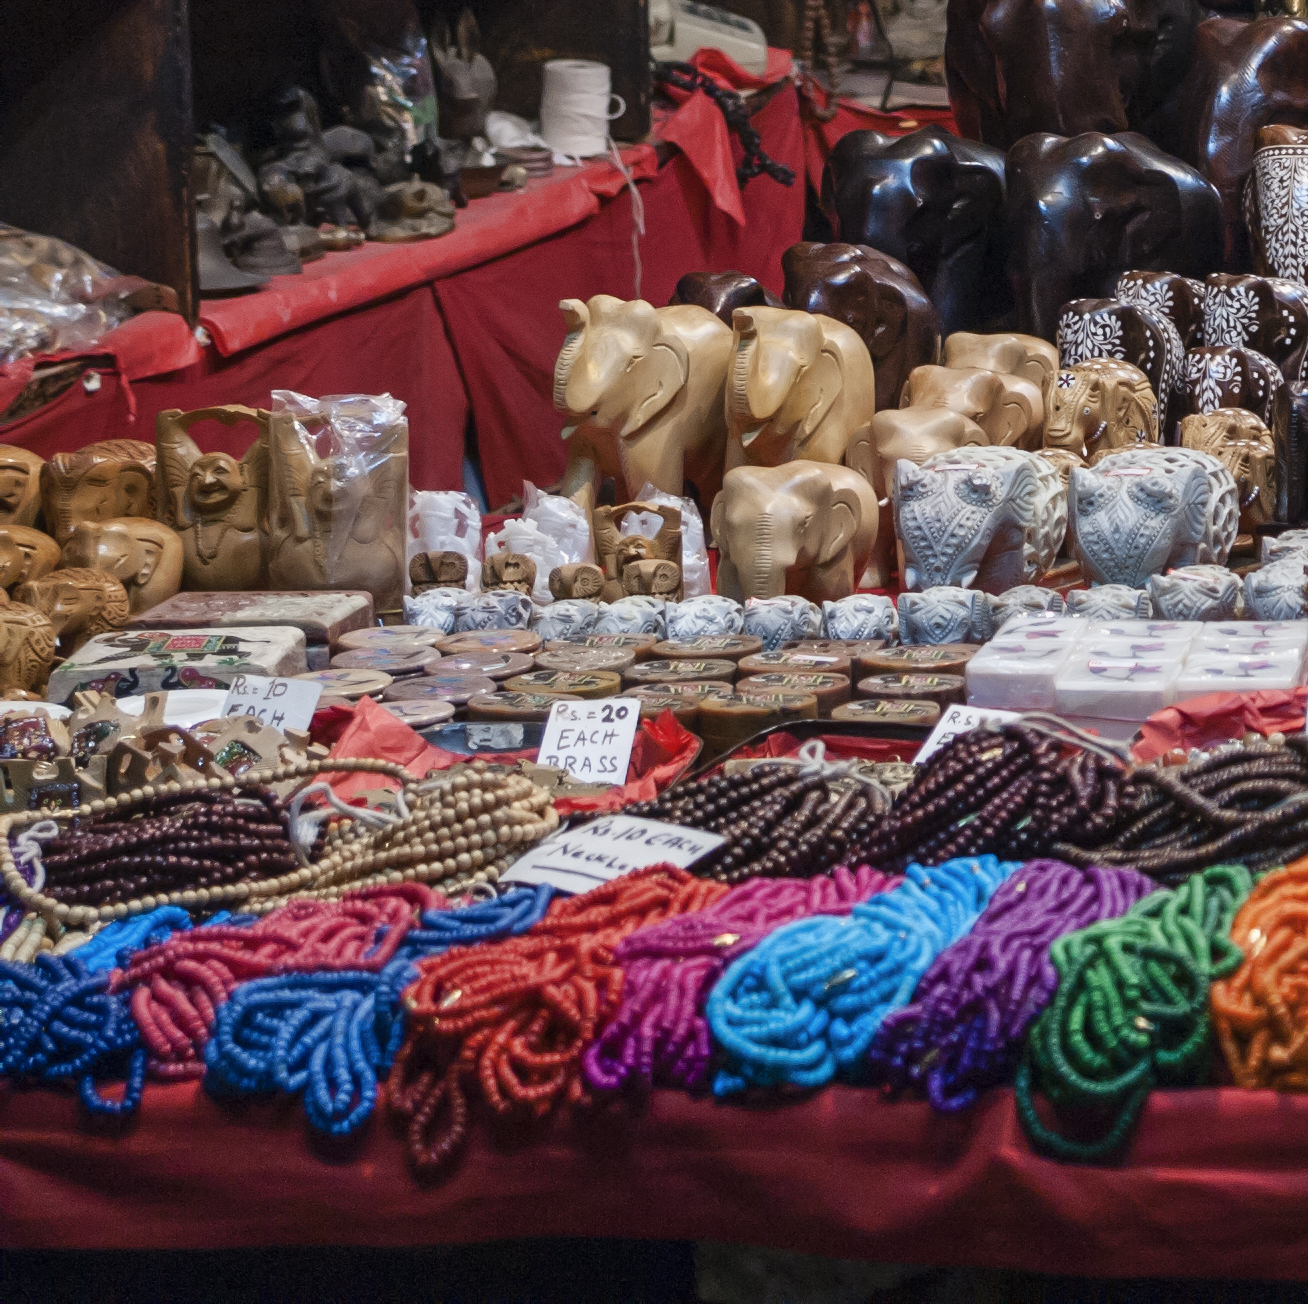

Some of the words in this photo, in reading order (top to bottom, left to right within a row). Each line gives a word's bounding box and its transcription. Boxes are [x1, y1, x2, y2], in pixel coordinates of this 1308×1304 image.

[263, 678, 288, 700] 10
[601, 704, 629, 723] 20
[556, 728, 620, 751] EACH
[545, 755, 618, 774] BRASS
